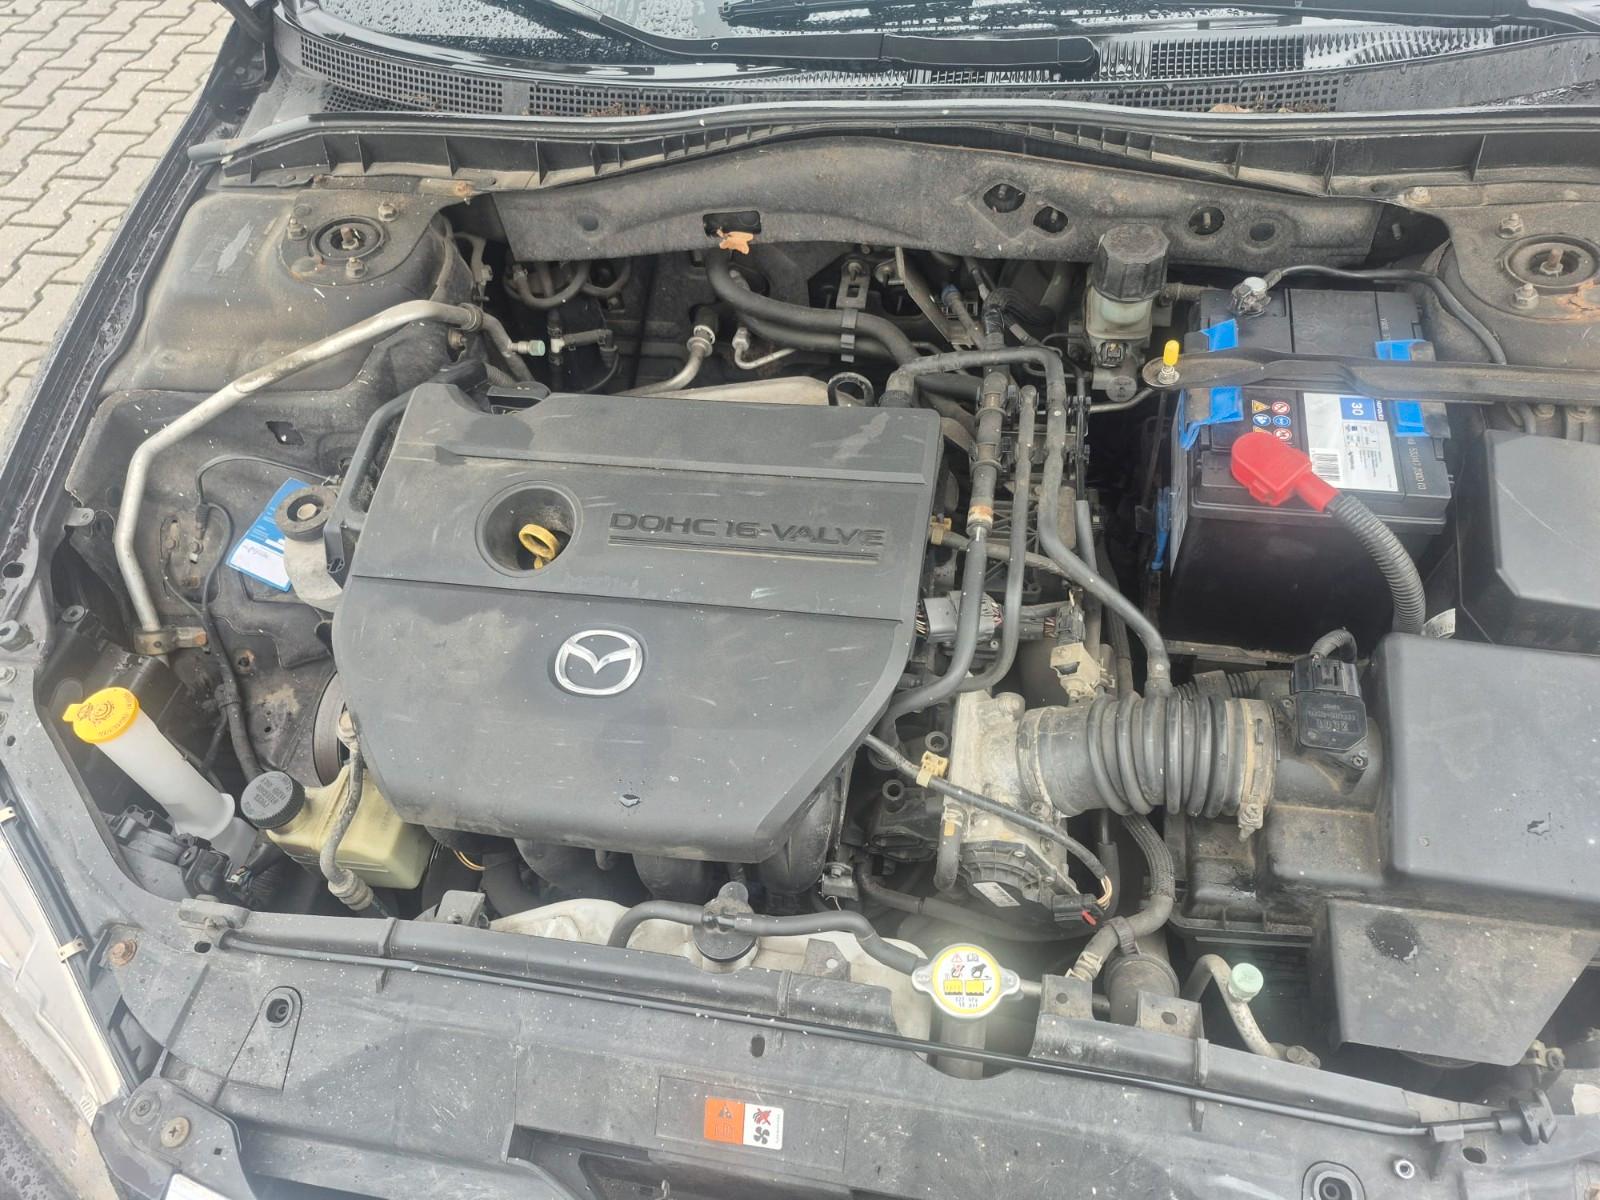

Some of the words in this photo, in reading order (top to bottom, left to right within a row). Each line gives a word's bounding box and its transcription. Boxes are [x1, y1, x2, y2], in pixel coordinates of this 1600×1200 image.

[1351, 401, 1364, 416] 30
[609, 512, 717, 536] DOHC
[725, 520, 885, 546] 16-VALVE
